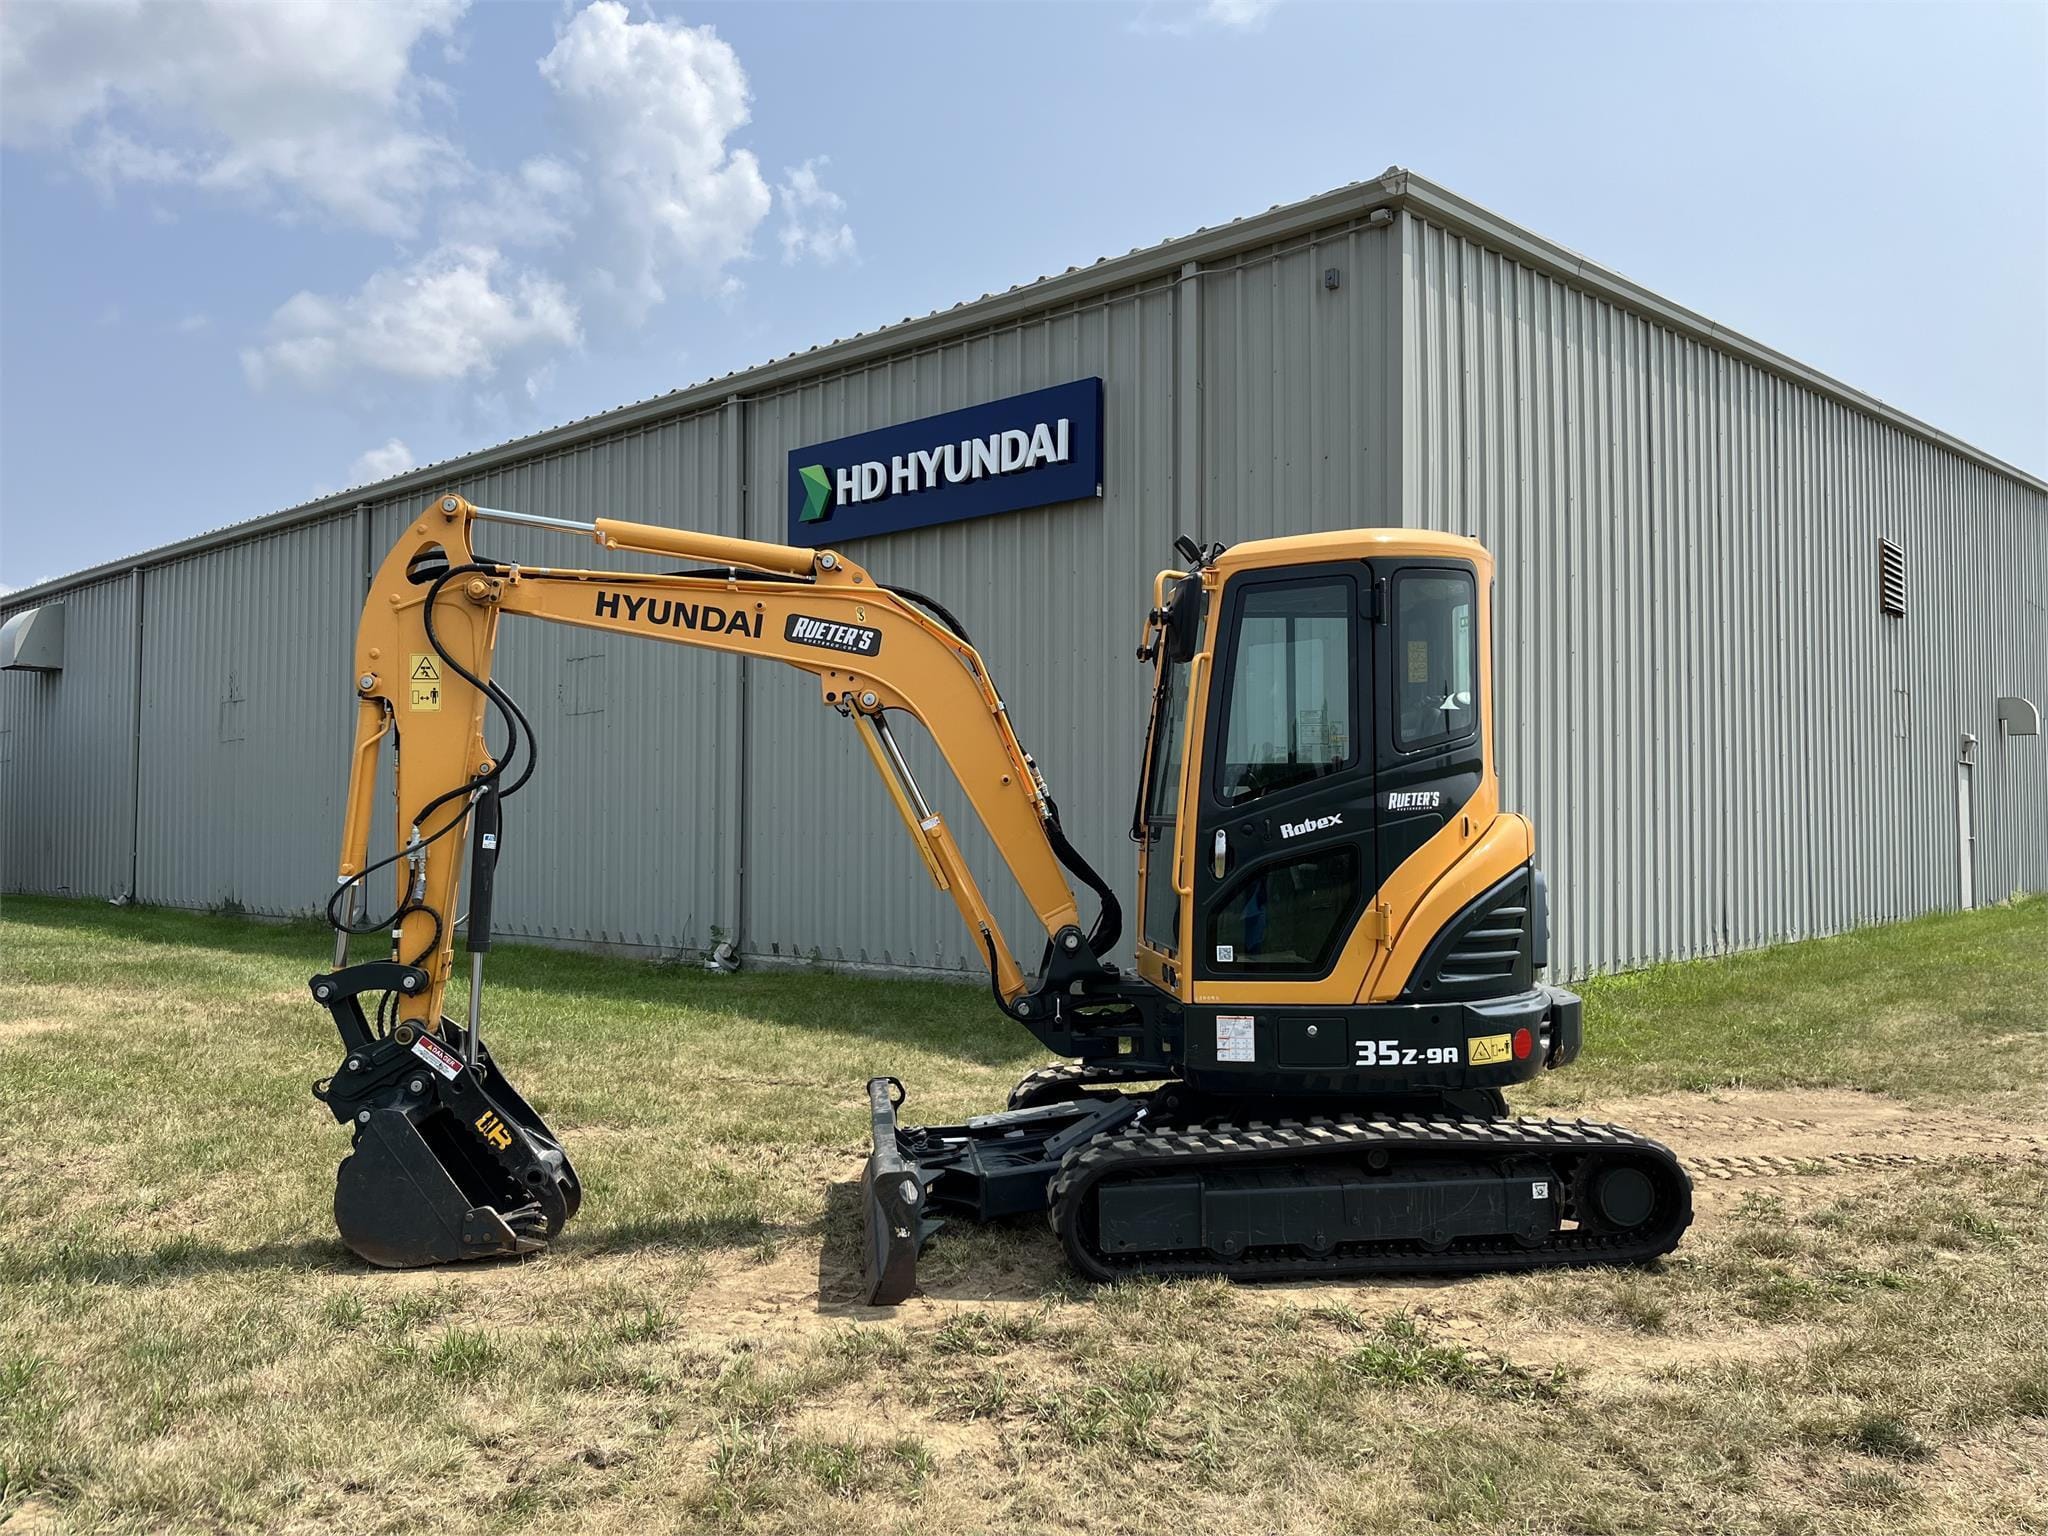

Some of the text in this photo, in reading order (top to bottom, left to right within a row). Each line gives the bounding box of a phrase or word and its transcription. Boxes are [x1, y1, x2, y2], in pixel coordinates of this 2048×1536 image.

[836, 418, 1069, 506] HD HYUNDAI
[595, 591, 764, 639] HYUNDAI
[791, 617, 874, 650] RUETER'S
[1388, 791, 1440, 810] RUETER'S
[1280, 813, 1343, 838] Robex
[431, 1046, 456, 1067] DANGER
